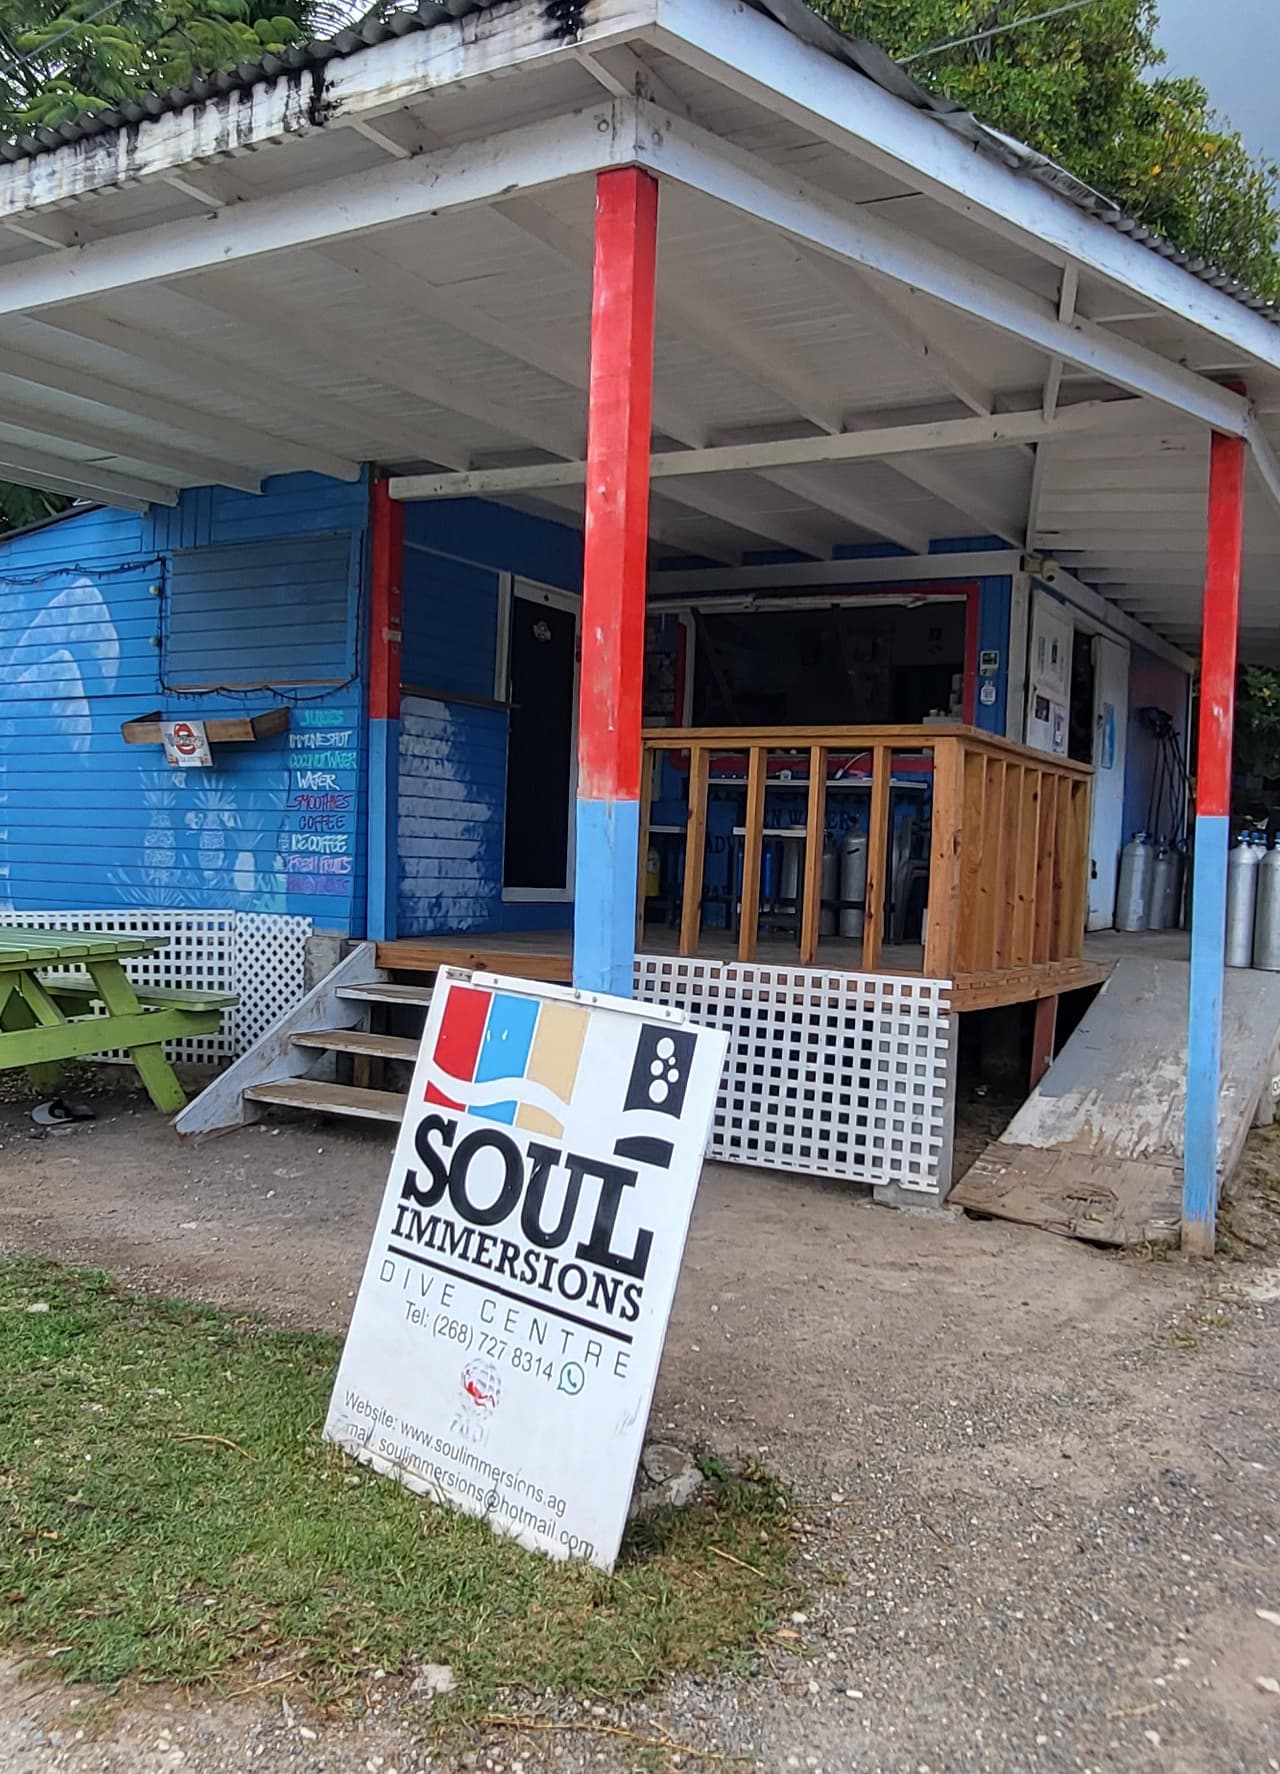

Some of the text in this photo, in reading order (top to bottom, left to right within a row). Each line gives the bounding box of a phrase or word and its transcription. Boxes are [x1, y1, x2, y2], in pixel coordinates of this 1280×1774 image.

[297, 771, 340, 790] WATER
[299, 814, 347, 832] COFFEE
[400, 1113, 654, 1281] SOUL
[380, 1259, 632, 1379] DIVE CENTRE
[391, 1204, 644, 1323] IMMERSIONS
[405, 1301, 554, 1382] Tel: (268) 727 8314
[344, 1389, 567, 1518] Website: www.soulimmersions.ag
[378, 1438, 595, 1560] soulimmersions@hotmail.com
